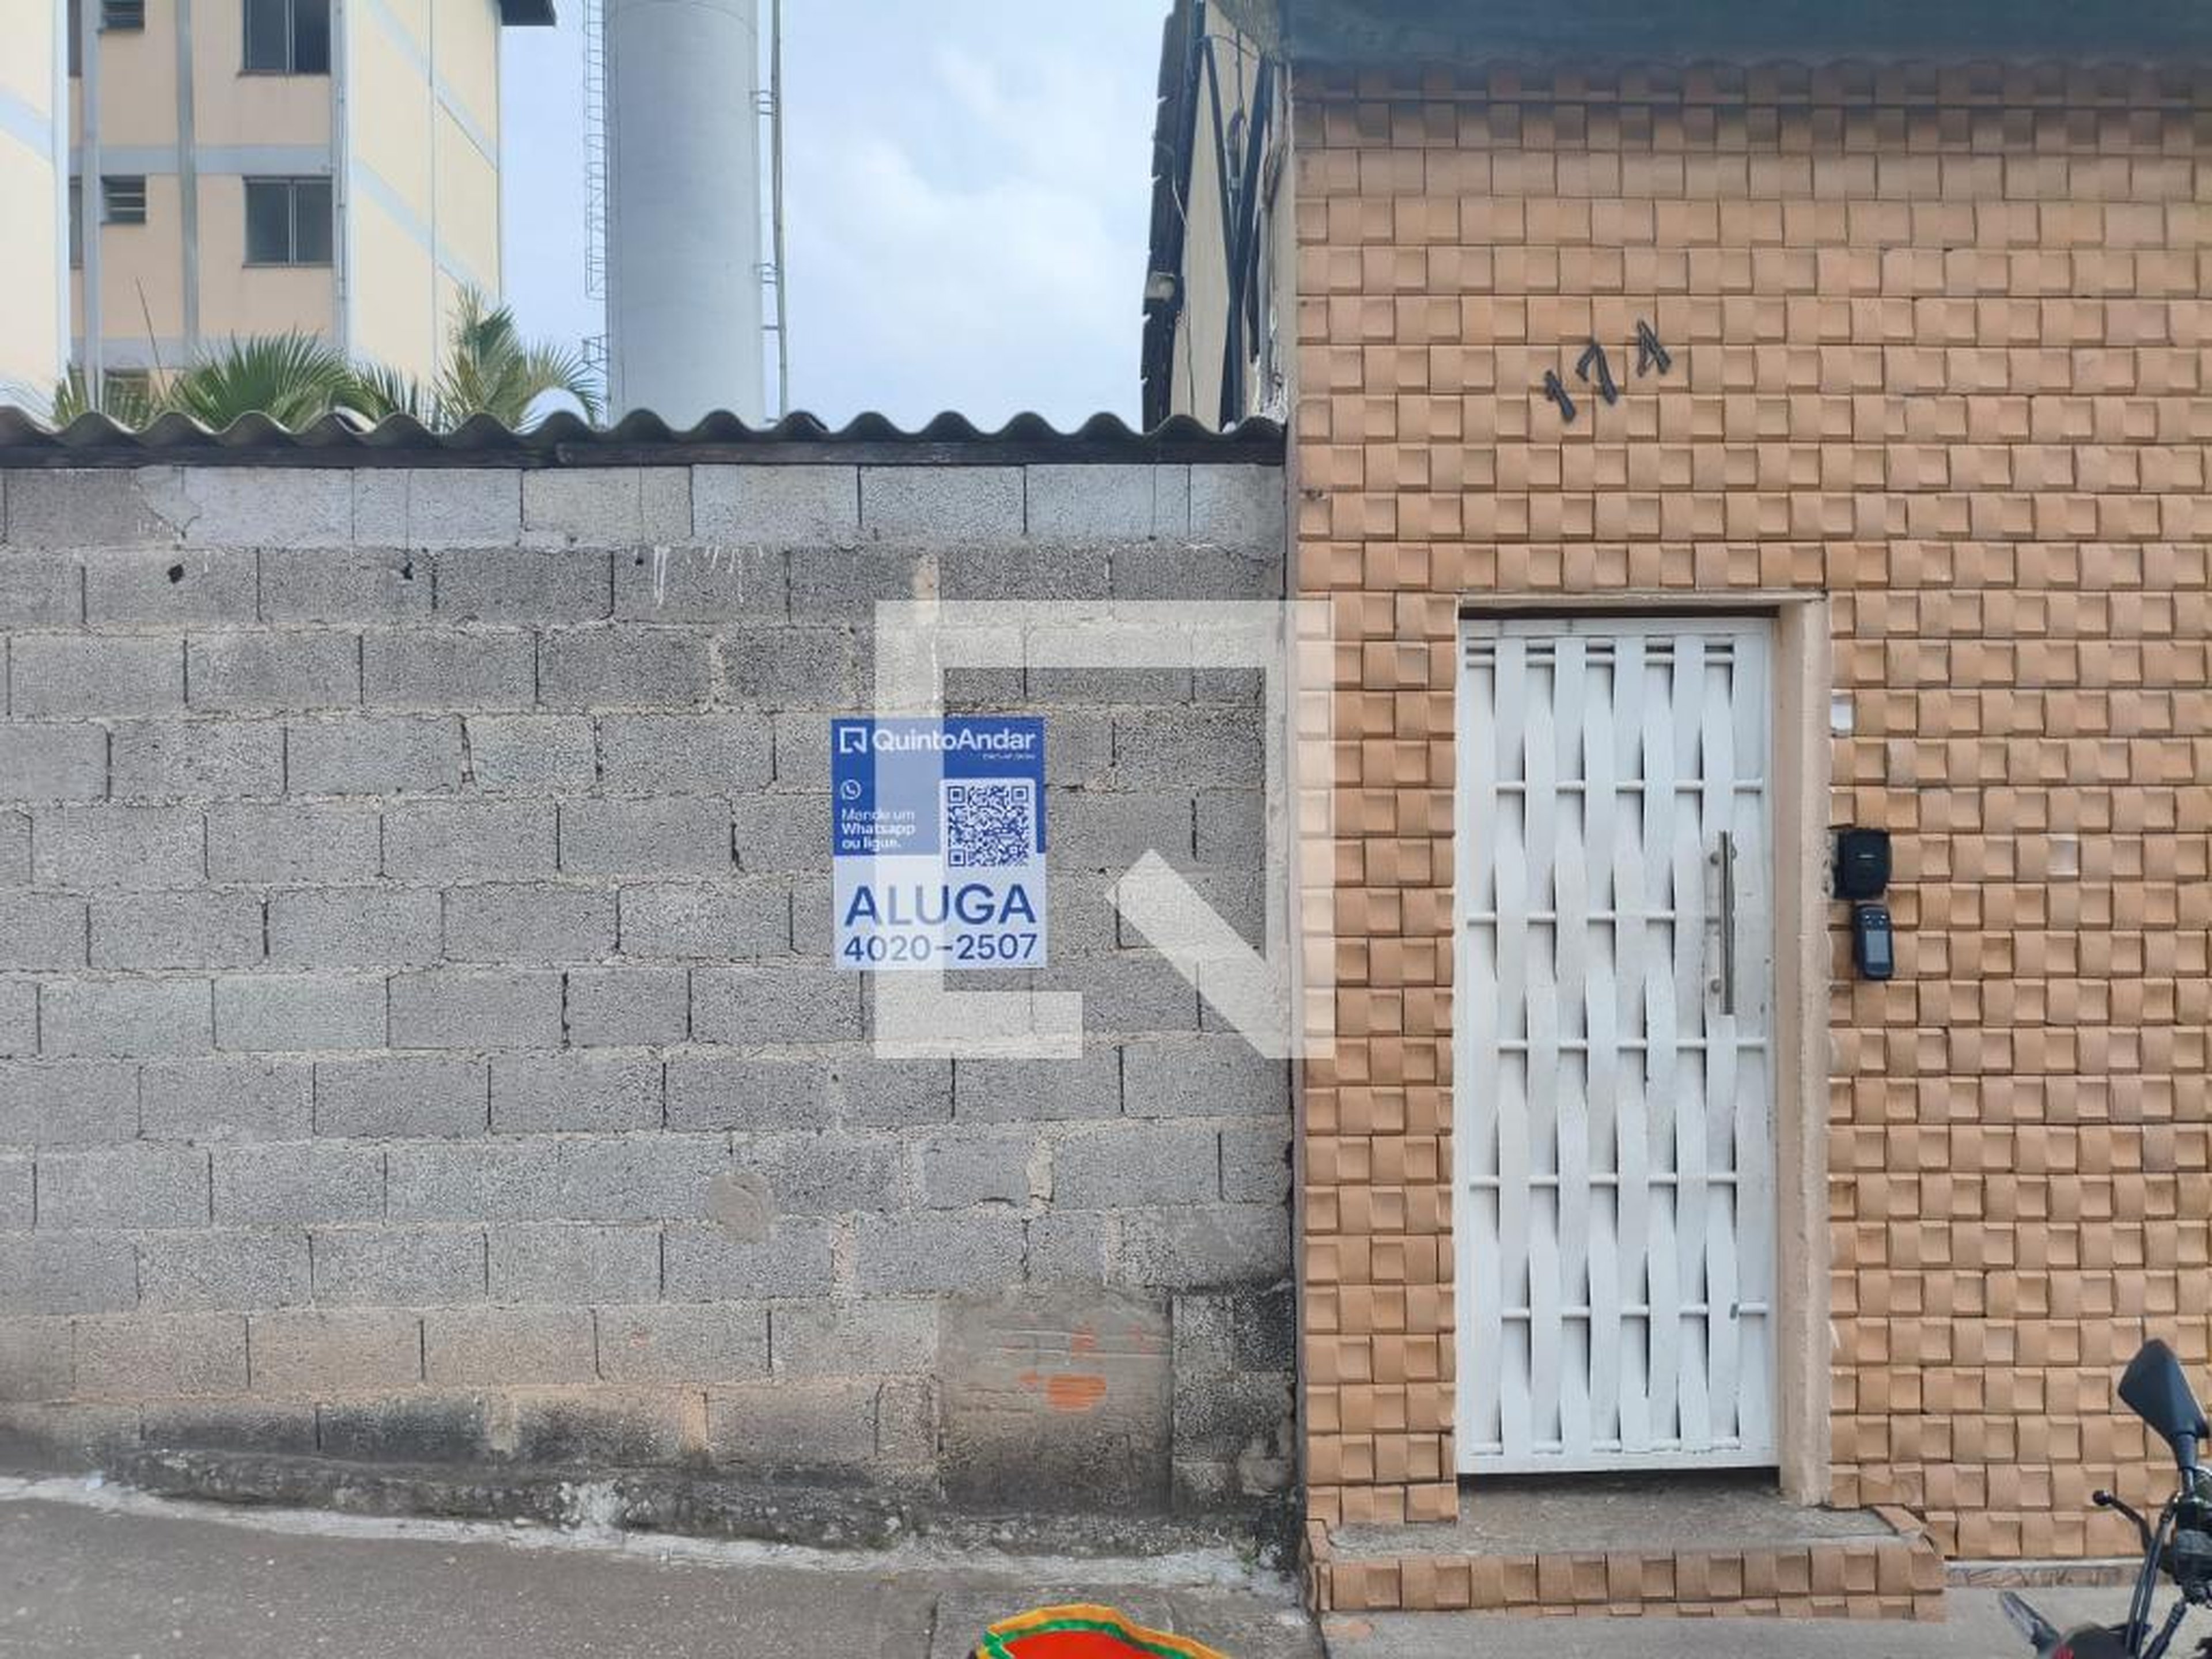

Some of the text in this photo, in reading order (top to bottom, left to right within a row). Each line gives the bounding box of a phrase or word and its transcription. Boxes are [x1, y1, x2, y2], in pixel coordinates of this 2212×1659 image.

[872, 728, 1036, 751] QuintoAndar
[893, 811, 915, 821] um
[842, 839, 861, 850] ou
[844, 883, 1036, 926] ALUGA
[844, 933, 1037, 961] 4020-2507
